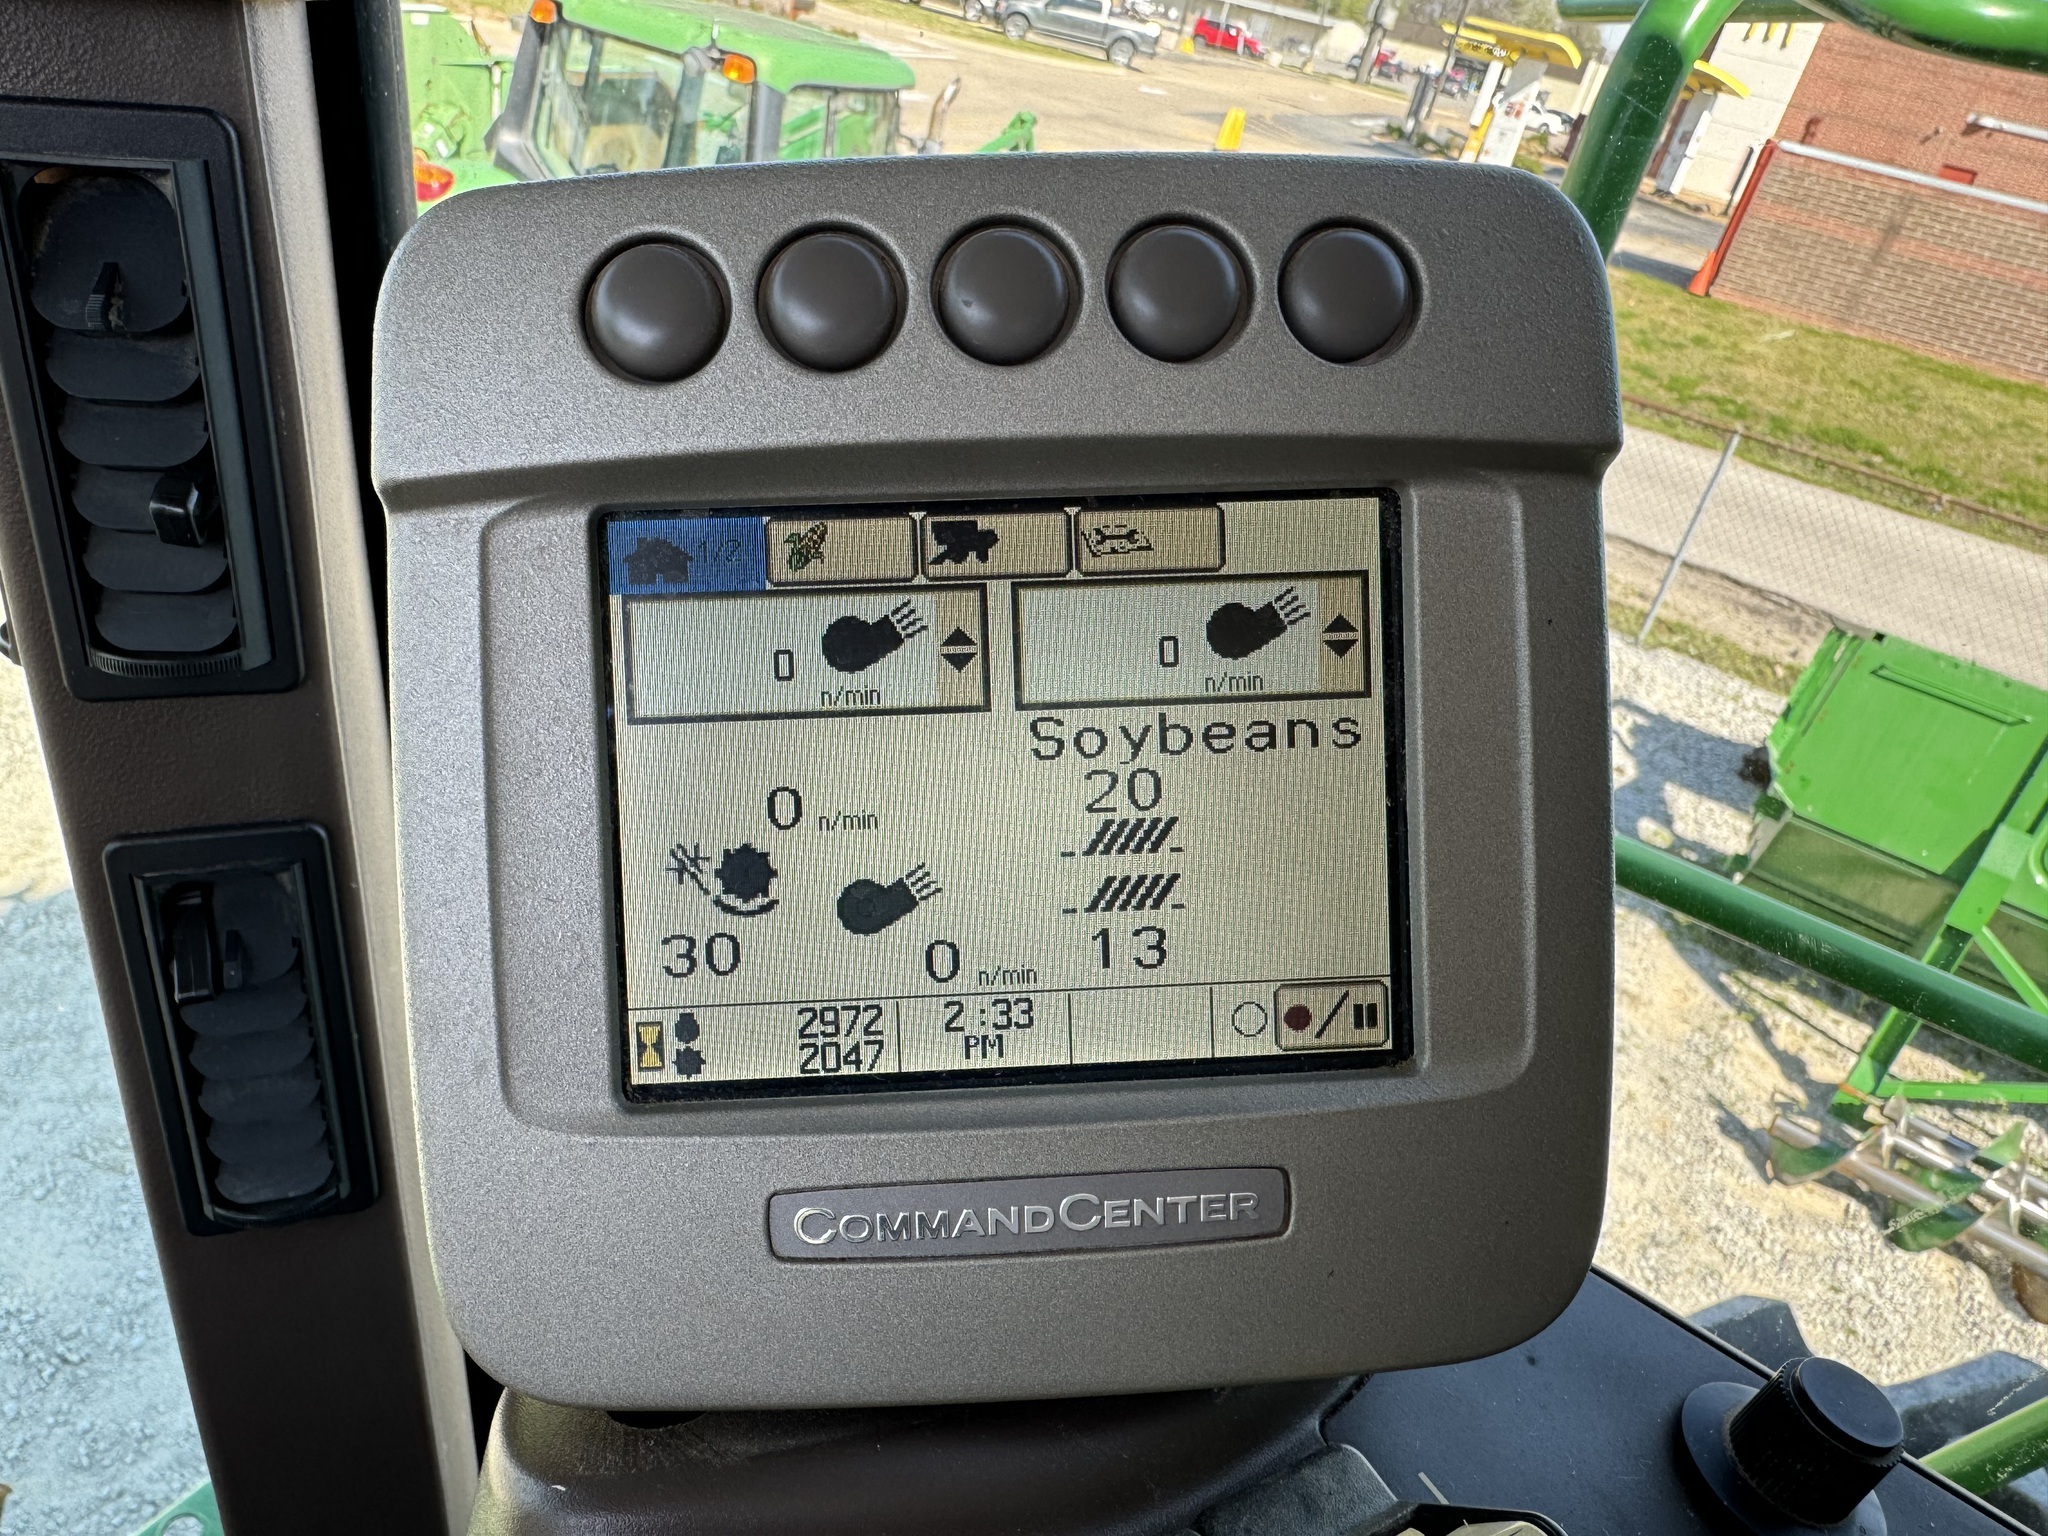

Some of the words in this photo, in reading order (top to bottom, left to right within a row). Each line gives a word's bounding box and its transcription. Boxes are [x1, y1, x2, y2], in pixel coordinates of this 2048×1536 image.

[821, 685, 880, 707] n/min
[1204, 672, 1263, 693] n/min
[1030, 713, 1361, 764] Soybeans
[767, 786, 802, 830] 0
[819, 811, 878, 831] n/min
[1084, 768, 1162, 813] 20
[661, 932, 741, 978] 30
[925, 940, 960, 983] 0
[978, 964, 1037, 986] n/min
[1091, 926, 1167, 970] 13
[798, 1004, 884, 1038] 2972
[944, 998, 1034, 1033] 2:33
[799, 1040, 884, 1074] 2047
[964, 1034, 1004, 1059] PM
